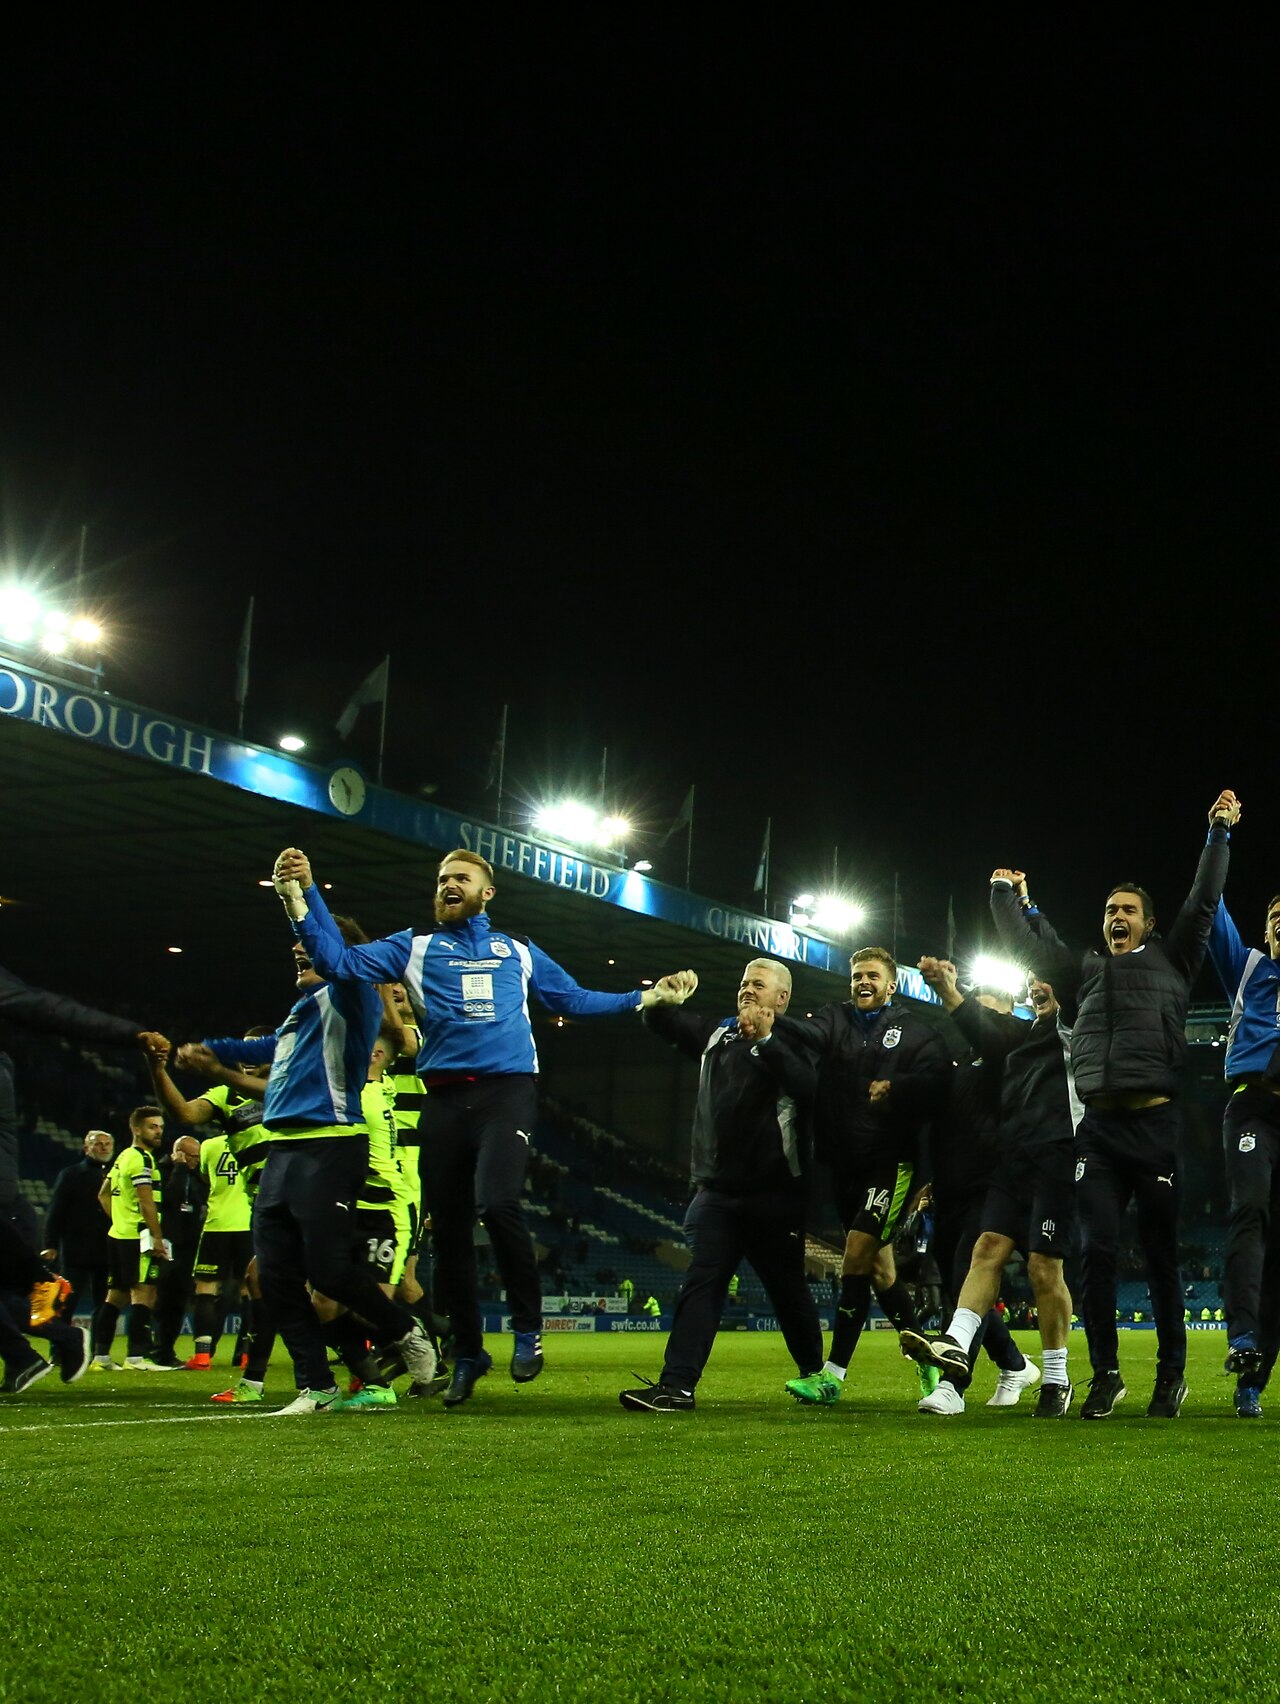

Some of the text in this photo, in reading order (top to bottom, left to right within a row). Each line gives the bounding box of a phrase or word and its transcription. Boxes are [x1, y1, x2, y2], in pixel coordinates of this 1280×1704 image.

[460, 822, 610, 898] SHEFFIELD
[707, 907, 809, 963] CHANSIRI
[217, 1152, 238, 1185] 4
[865, 1187, 890, 1215] 14
[1042, 1219, 1056, 1231] dh
[366, 1238, 395, 1264] 16
[611, 1318, 661, 1331] swfc.co.uk
